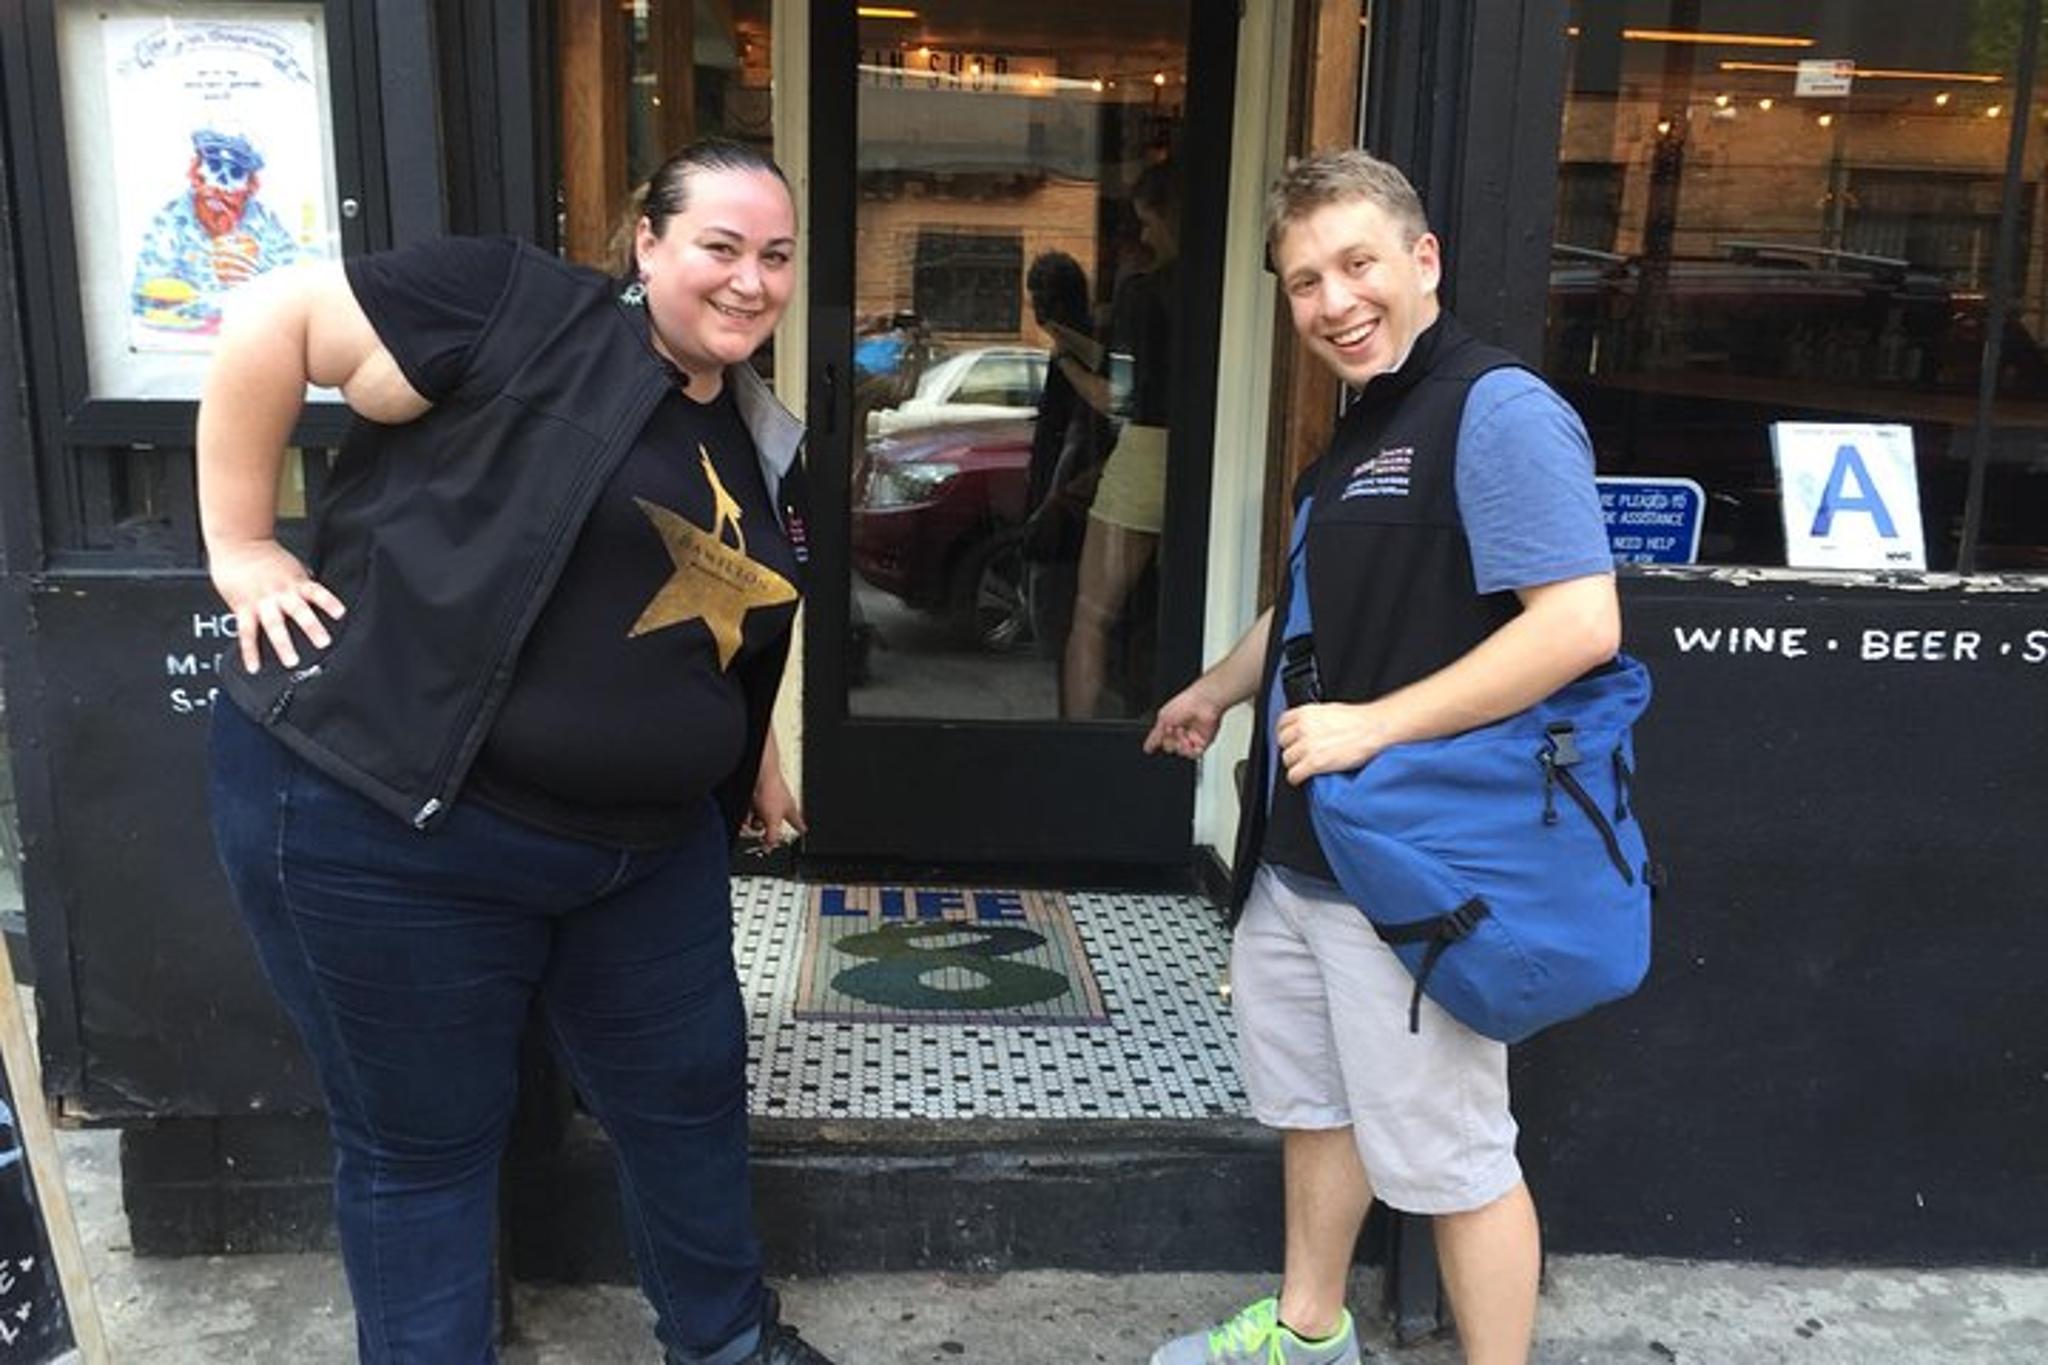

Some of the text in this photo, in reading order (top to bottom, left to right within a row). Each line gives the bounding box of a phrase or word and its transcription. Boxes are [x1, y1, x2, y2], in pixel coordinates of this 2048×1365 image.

[1810, 444, 1899, 538] A
[1620, 511, 1685, 527] ASSISTANCE
[1612, 536, 1676, 551] NEED HELP
[193, 613, 240, 638] HO
[1673, 627, 1808, 658] WINE
[1861, 630, 1981, 661] BEER
[820, 888, 1027, 920] LIFE
